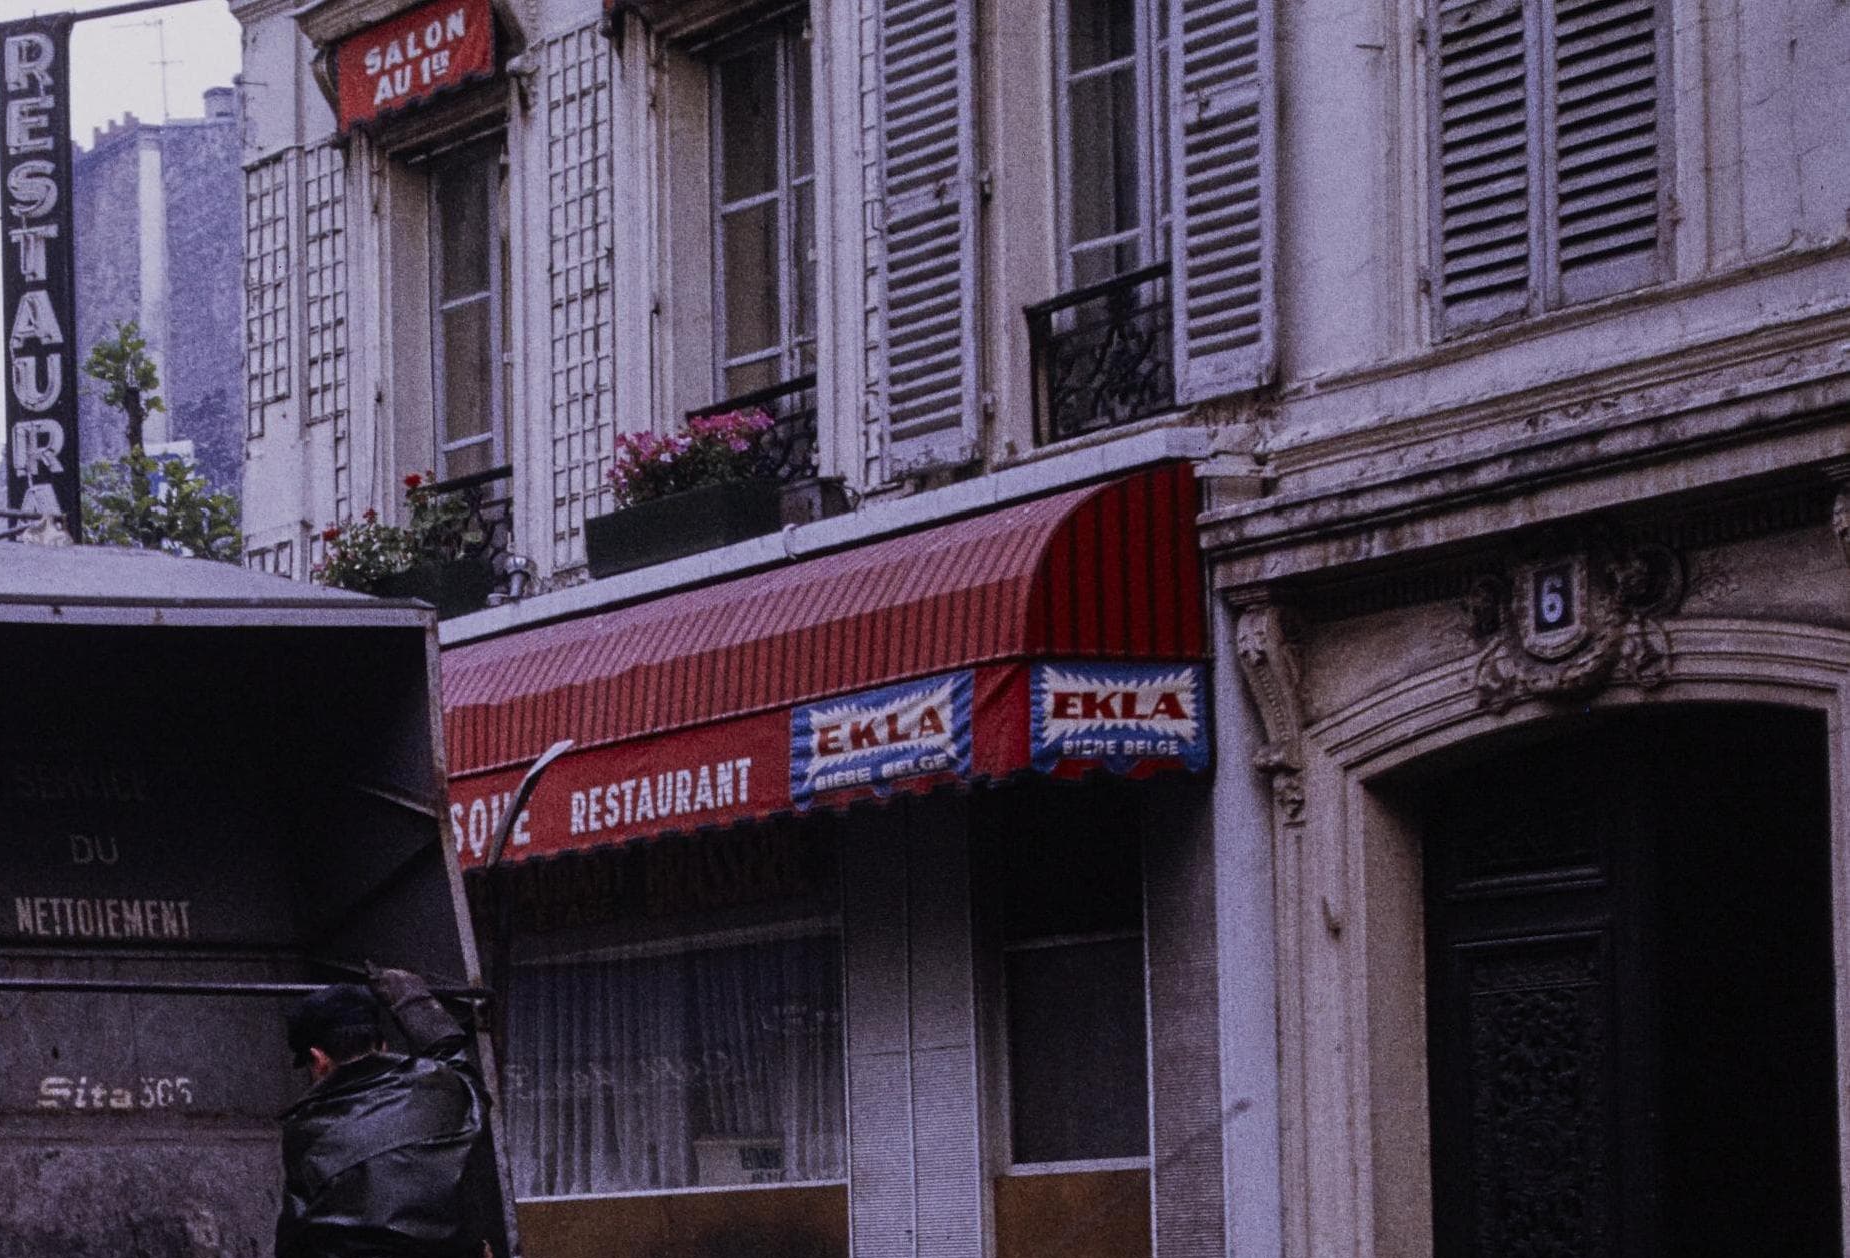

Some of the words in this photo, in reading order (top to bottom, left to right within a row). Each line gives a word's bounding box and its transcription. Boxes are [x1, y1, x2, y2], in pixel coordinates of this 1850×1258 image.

[364, 8, 465, 75] SALON
[374, 64, 412, 105] AU
[1541, 576, 1563, 623] 6
[1052, 691, 1189, 720] EKLA
[818, 706, 946, 757] EKLA
[1124, 739, 1180, 756] BELGE
[881, 752, 948, 778] BELGE
[570, 757, 752, 836] RESTAURANT
[69, 832, 120, 865] DU
[14, 895, 191, 940] NETTOIEMENT
[36, 1075, 135, 1110] Sita
